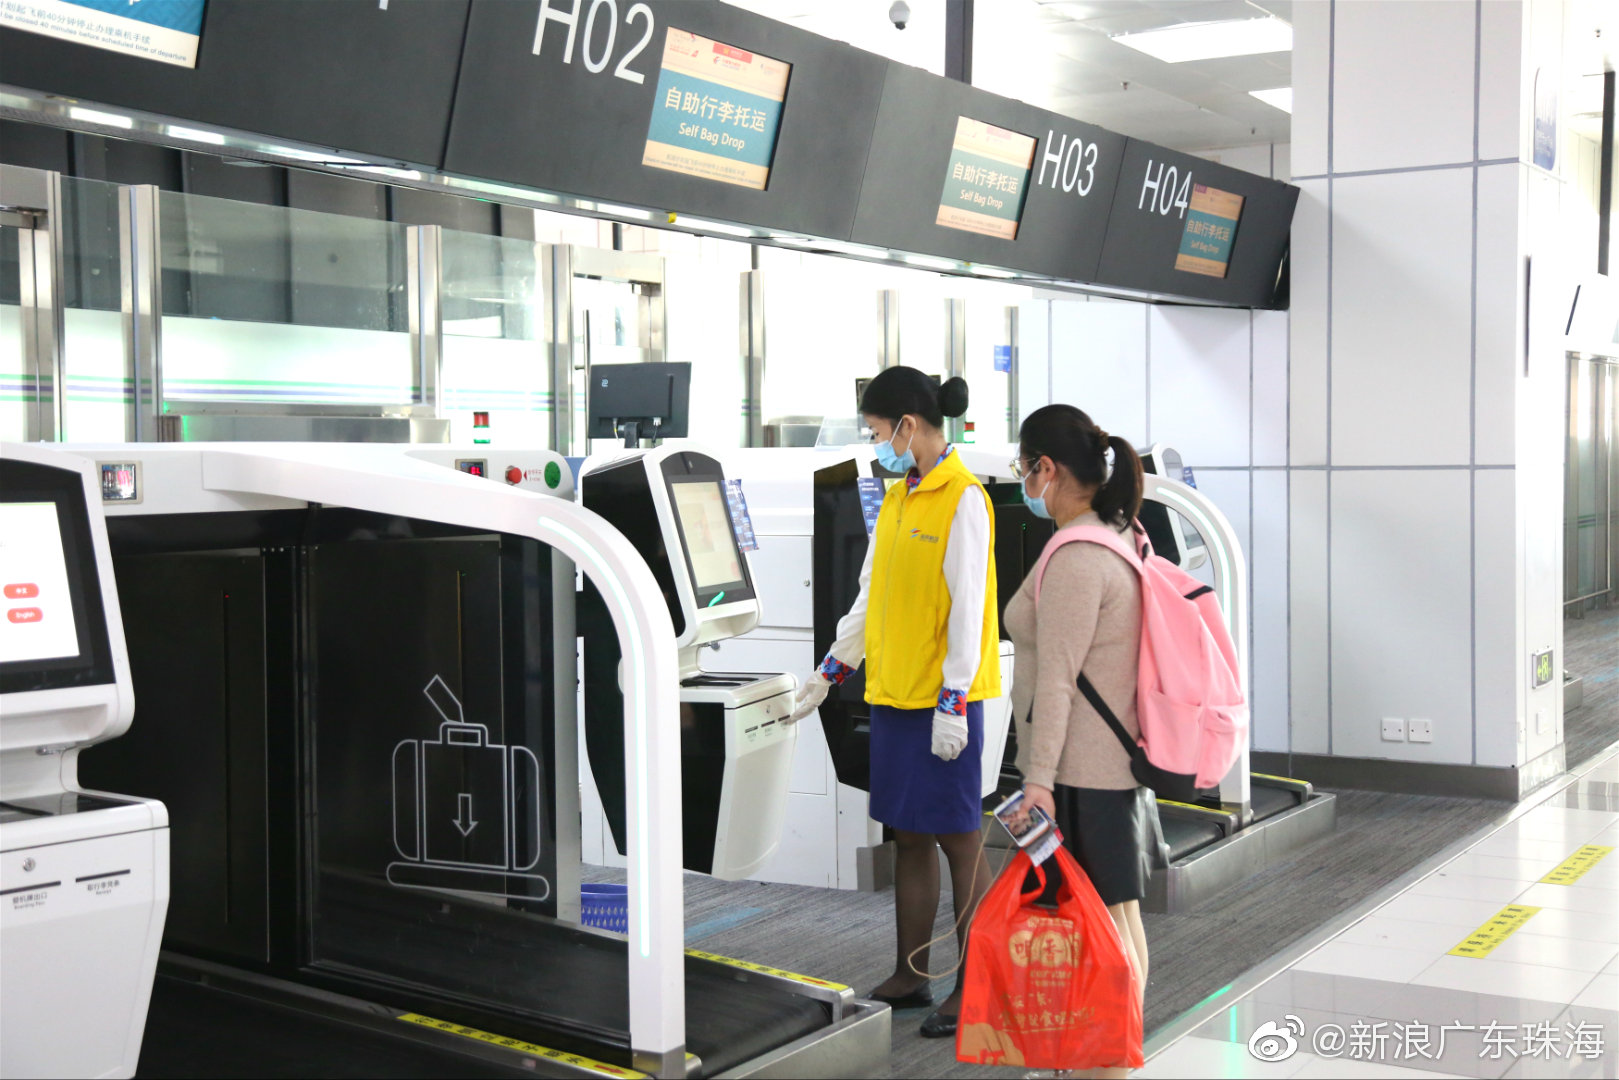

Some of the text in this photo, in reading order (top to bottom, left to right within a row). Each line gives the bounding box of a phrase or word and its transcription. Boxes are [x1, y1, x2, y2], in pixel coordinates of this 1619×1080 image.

[532, 0, 655, 85] H02
[665, 86, 768, 133] 自助行李托运
[678, 122, 745, 151] Self Bag Drop
[952, 161, 1019, 195] 自助行李托运
[1038, 129, 1098, 197] H03
[960, 189, 1003, 210] Self Bag Drop
[1138, 159, 1193, 219] H04
